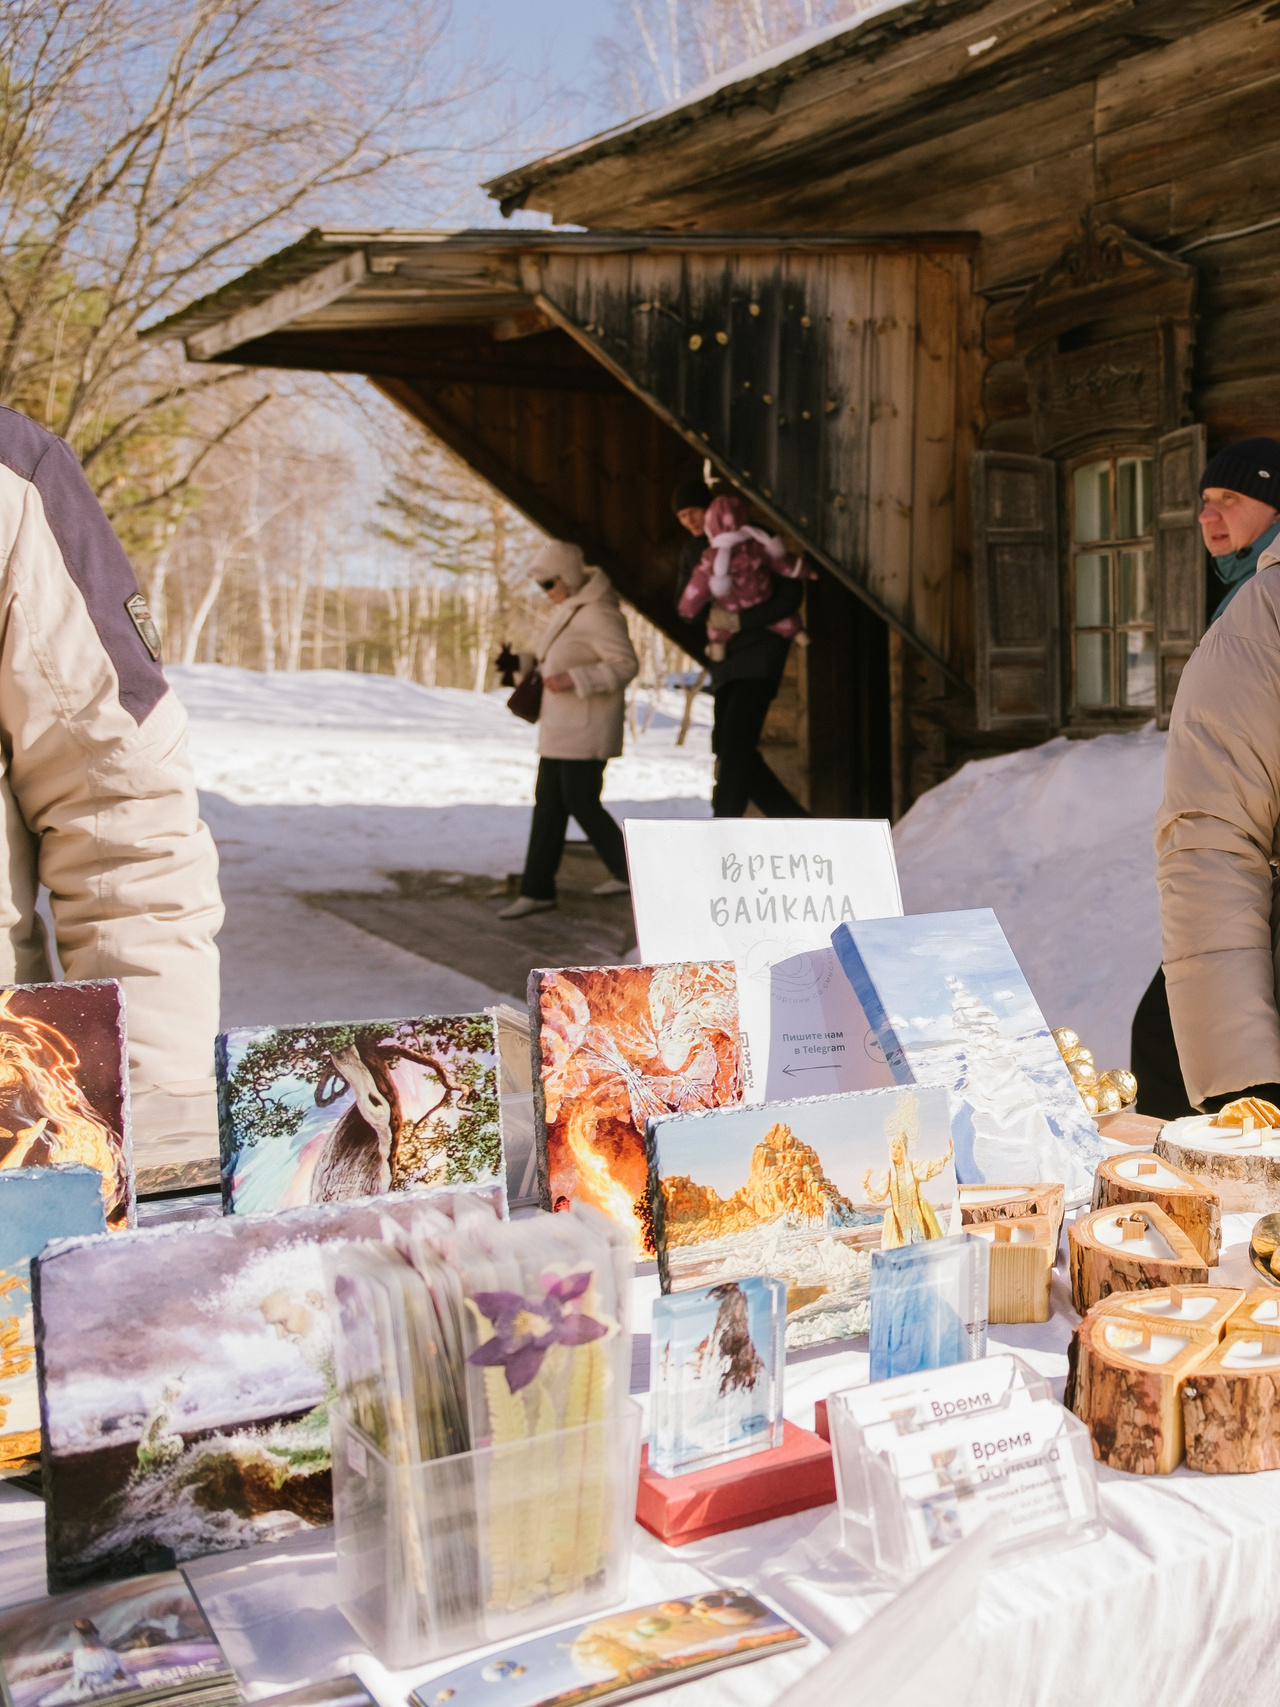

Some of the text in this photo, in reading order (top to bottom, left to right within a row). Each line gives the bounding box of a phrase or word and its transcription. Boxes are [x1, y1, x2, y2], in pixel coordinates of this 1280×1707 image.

[721, 853, 834, 885] ВРЕМЯ
[710, 887, 857, 927] БАЙКАЛА
[782, 1031, 844, 1042] Пишите нам
[794, 1044, 846, 1055] в Telegram
[931, 1392, 992, 1417] Время
[972, 1432, 1032, 1460] Время
